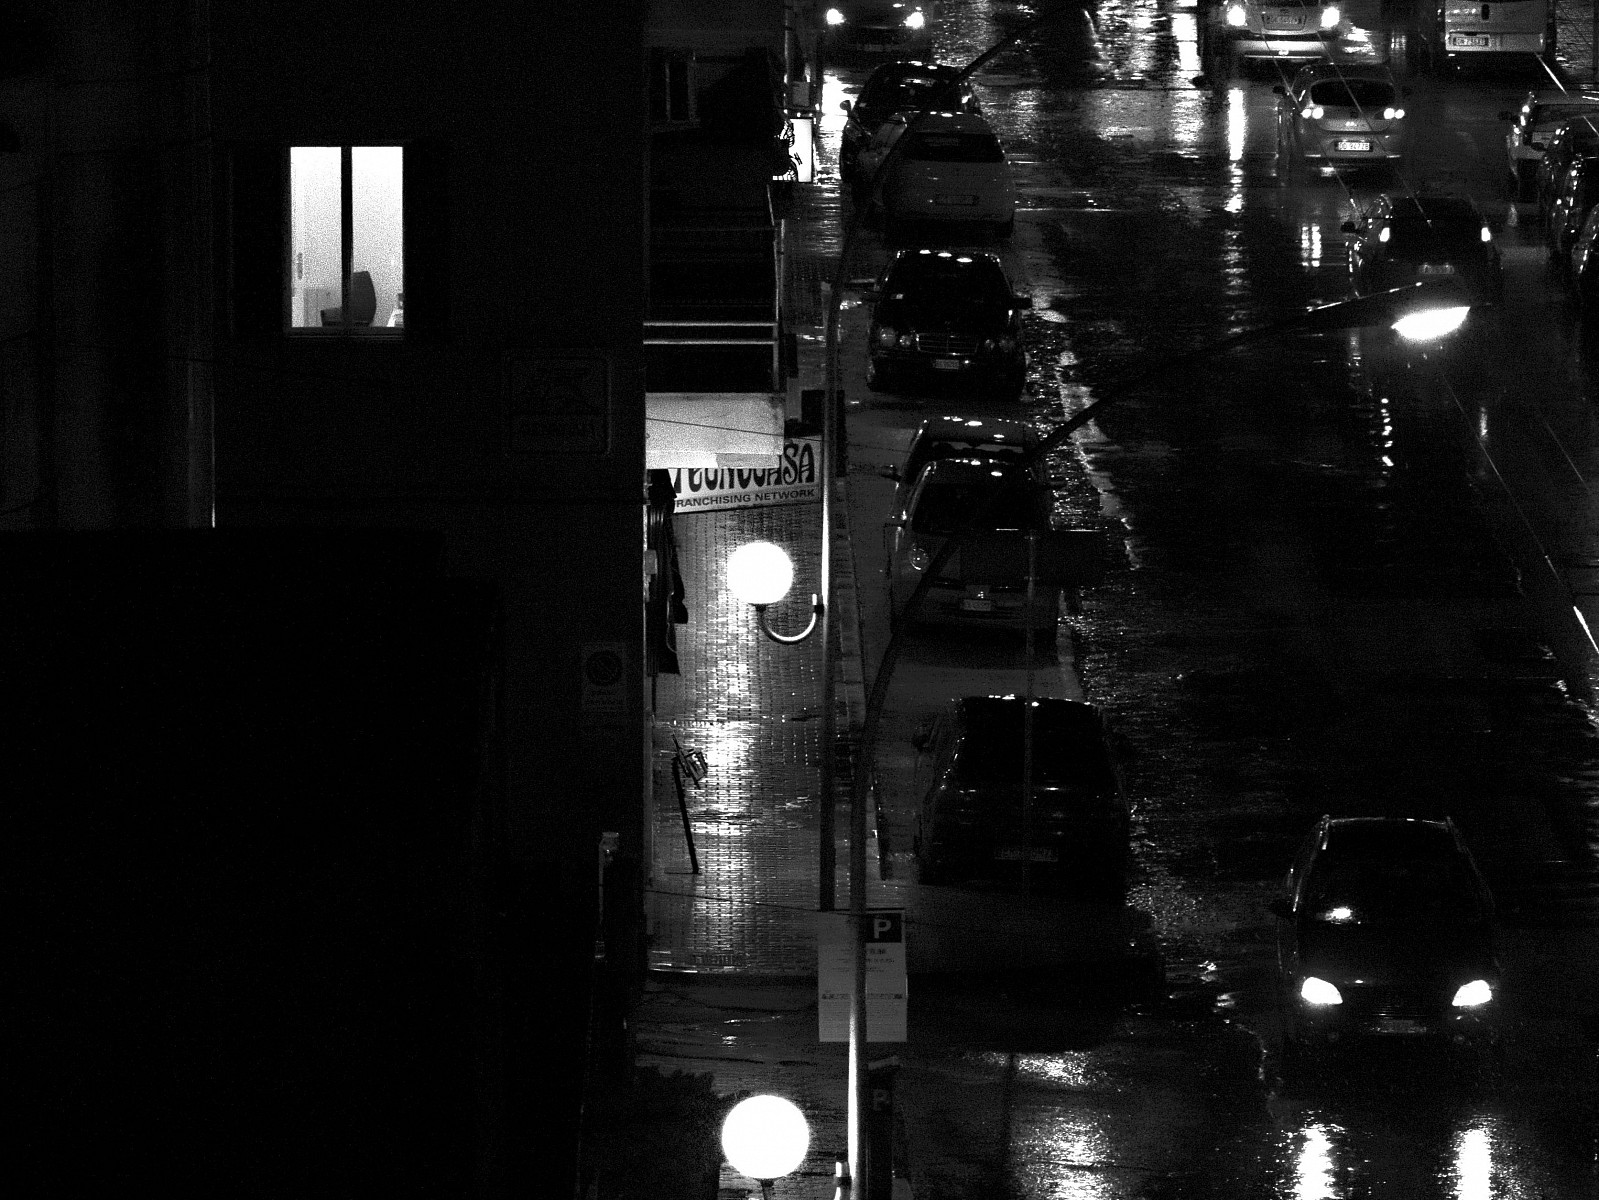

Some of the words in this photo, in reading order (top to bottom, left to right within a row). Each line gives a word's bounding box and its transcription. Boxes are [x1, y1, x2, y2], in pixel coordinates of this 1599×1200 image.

[676, 494, 751, 508] RANCHISING
[755, 489, 815, 502] NETWORK
[873, 918, 892, 939] P
